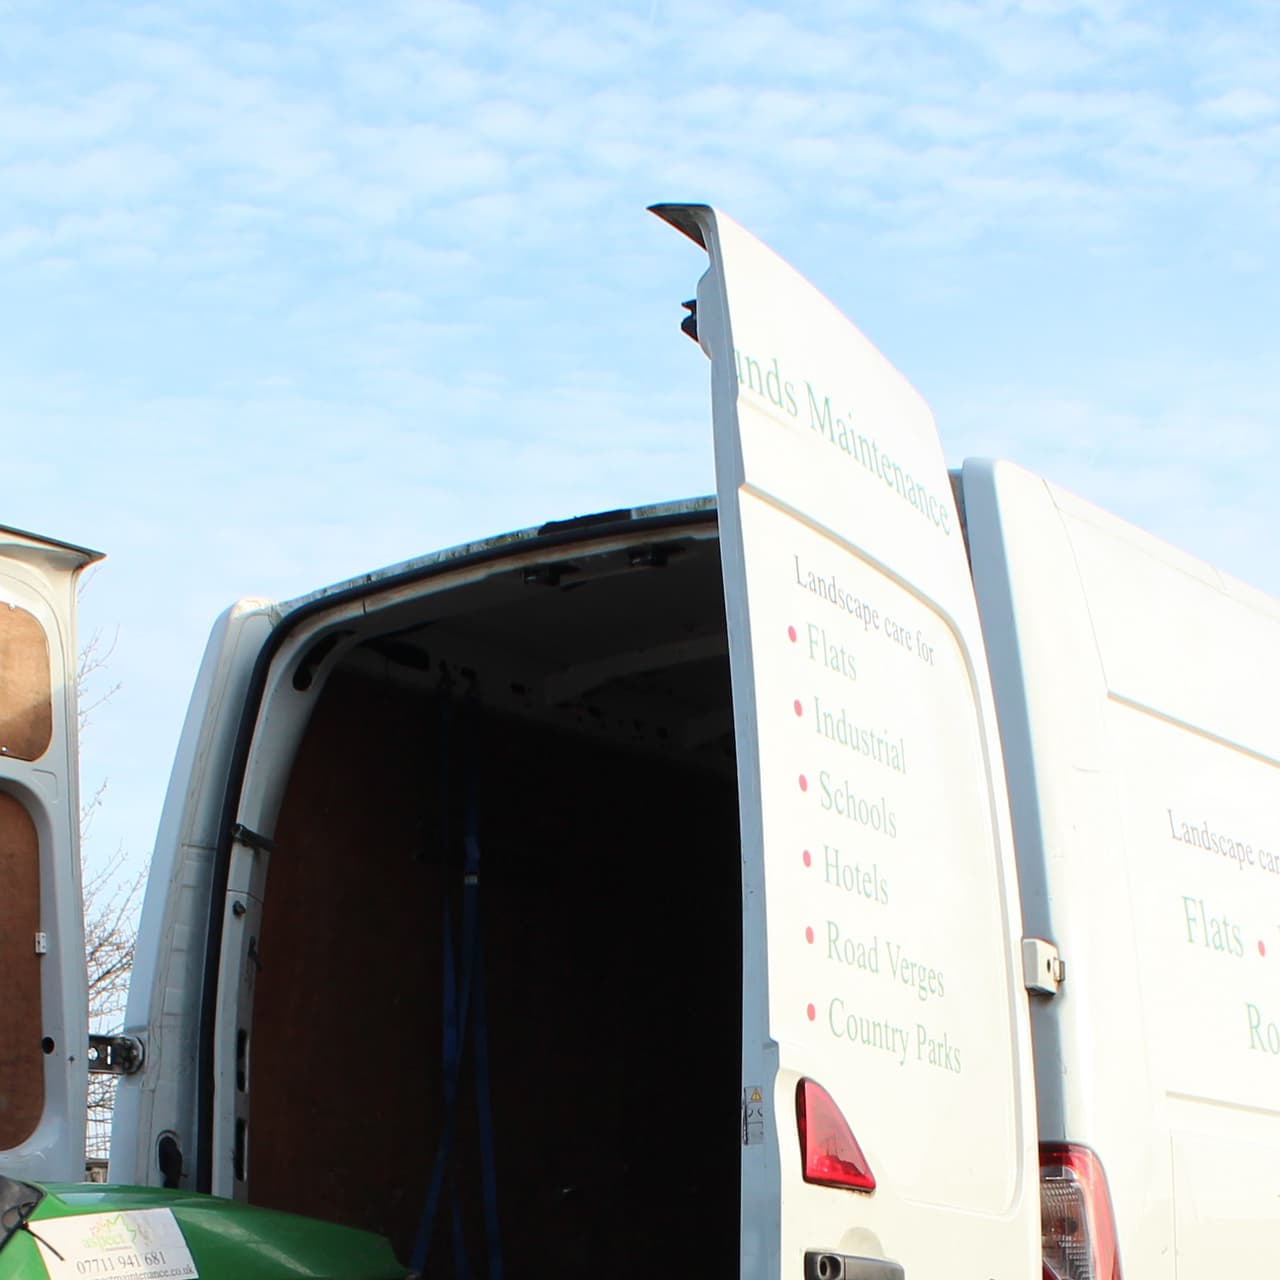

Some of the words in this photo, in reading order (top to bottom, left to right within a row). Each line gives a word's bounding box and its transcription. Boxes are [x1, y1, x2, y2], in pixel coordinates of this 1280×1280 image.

[805, 380, 951, 536] Maintenance
[794, 554, 881, 630] Landscape
[884, 619, 913, 652] care
[916, 629, 935, 667] for
[807, 622, 858, 681] Flats
[814, 696, 907, 775] Industrial
[819, 770, 897, 840] Schools
[1167, 808, 1255, 872] Landscape
[823, 844, 889, 906] Hotels
[825, 919, 880, 975] Road
[885, 940, 946, 1002] Verges
[1181, 895, 1245, 958] Flats
[828, 997, 910, 1067] Country
[916, 1023, 962, 1075] Parks
[76, 1256, 116, 1275] 07711
[119, 1253, 142, 1270] 941
[144, 1250, 167, 1267] 681
